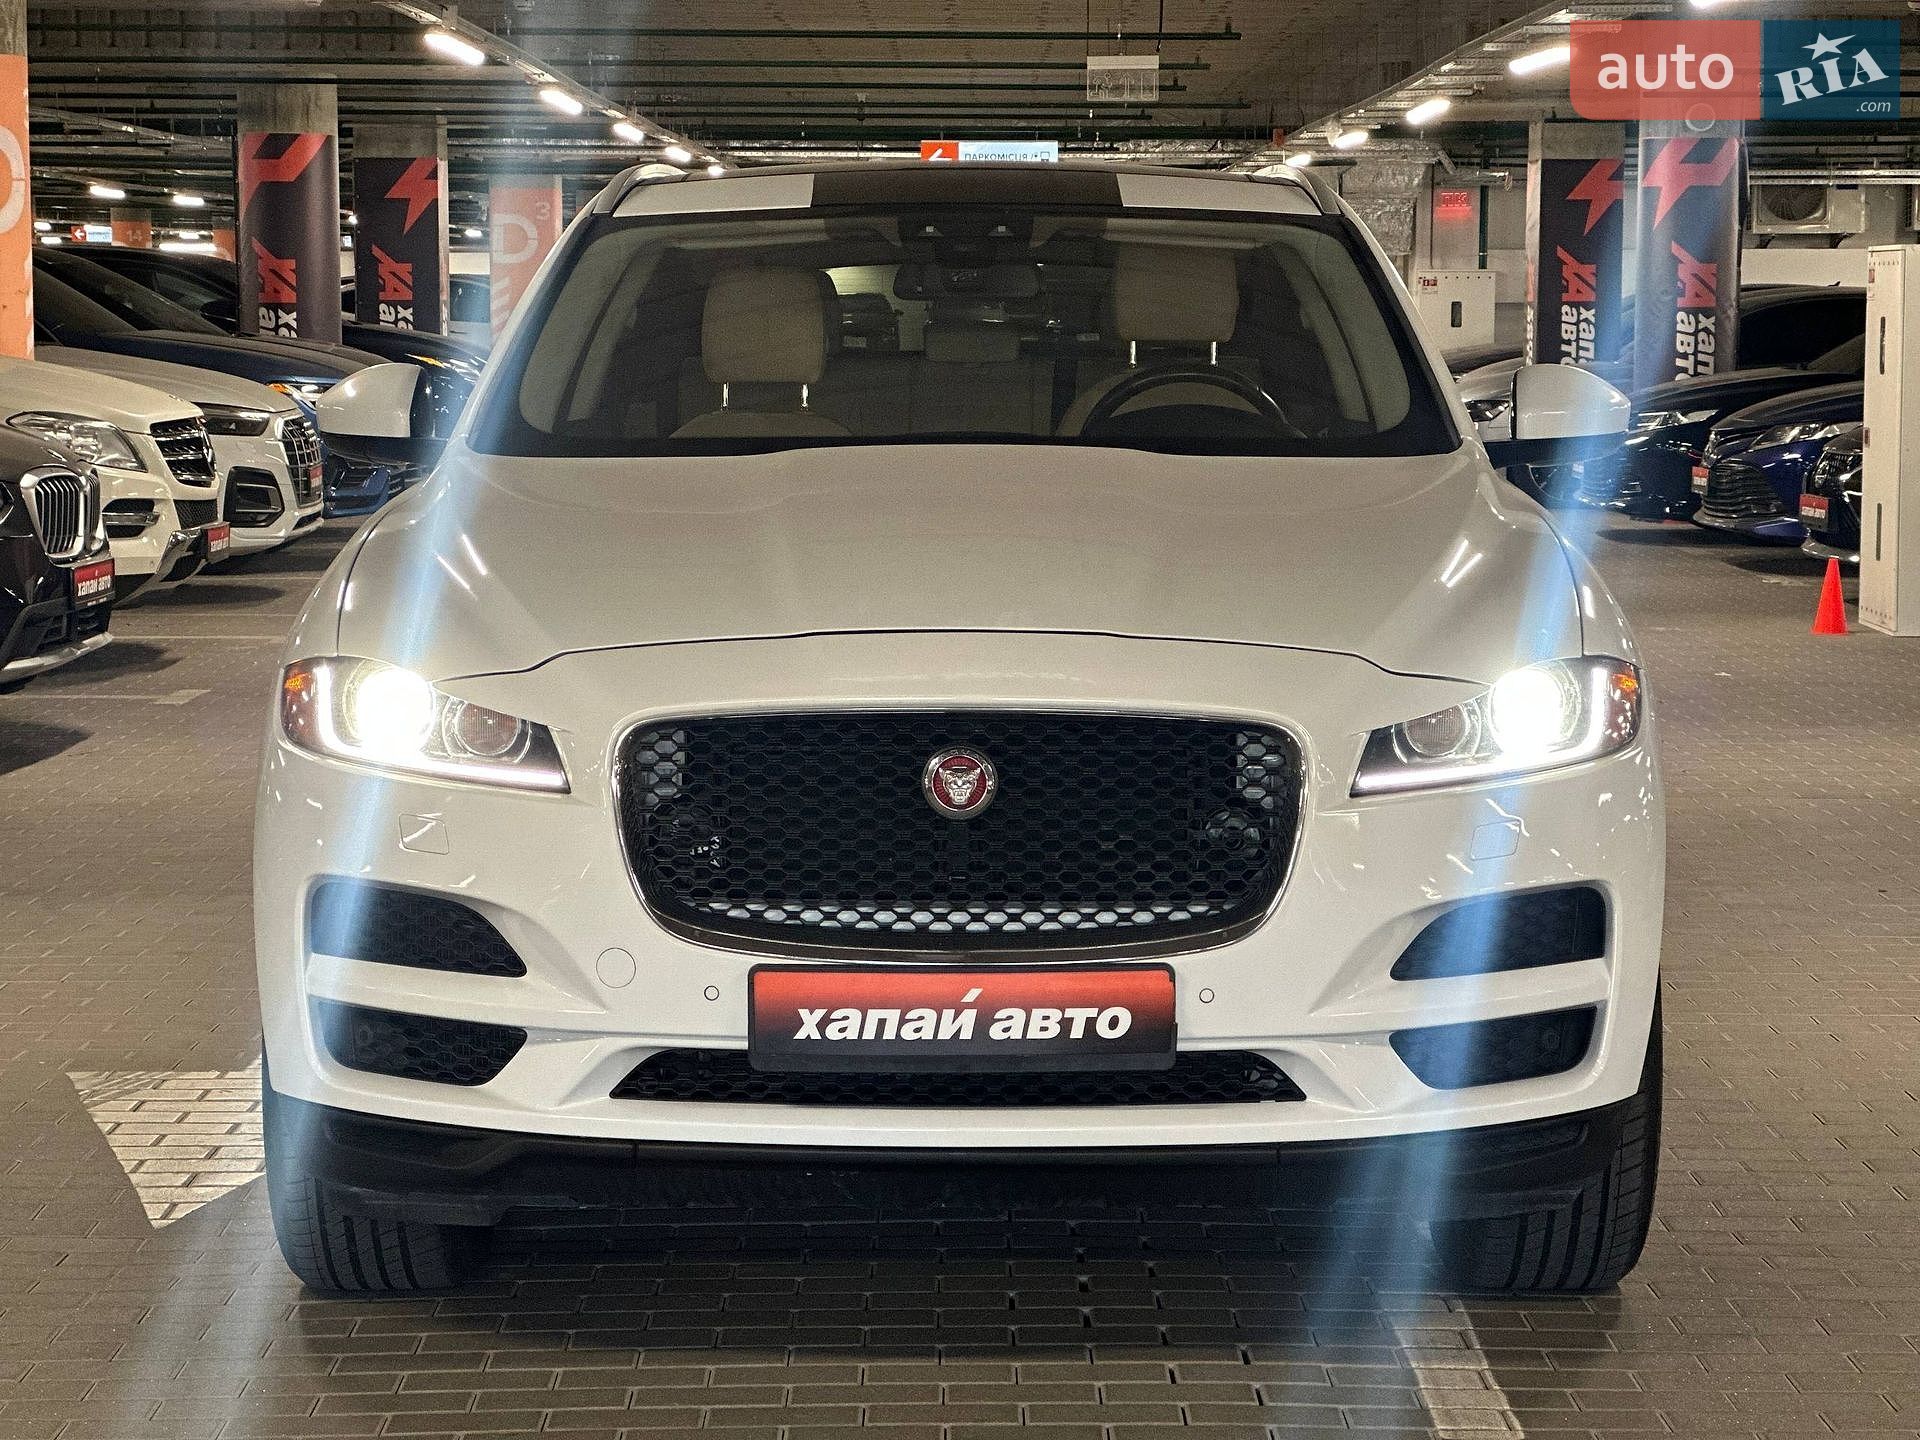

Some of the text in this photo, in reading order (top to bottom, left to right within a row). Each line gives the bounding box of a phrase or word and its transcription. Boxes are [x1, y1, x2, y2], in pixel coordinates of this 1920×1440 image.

[492, 213, 539, 264] D
[792, 987, 1133, 1041] хапай авто
